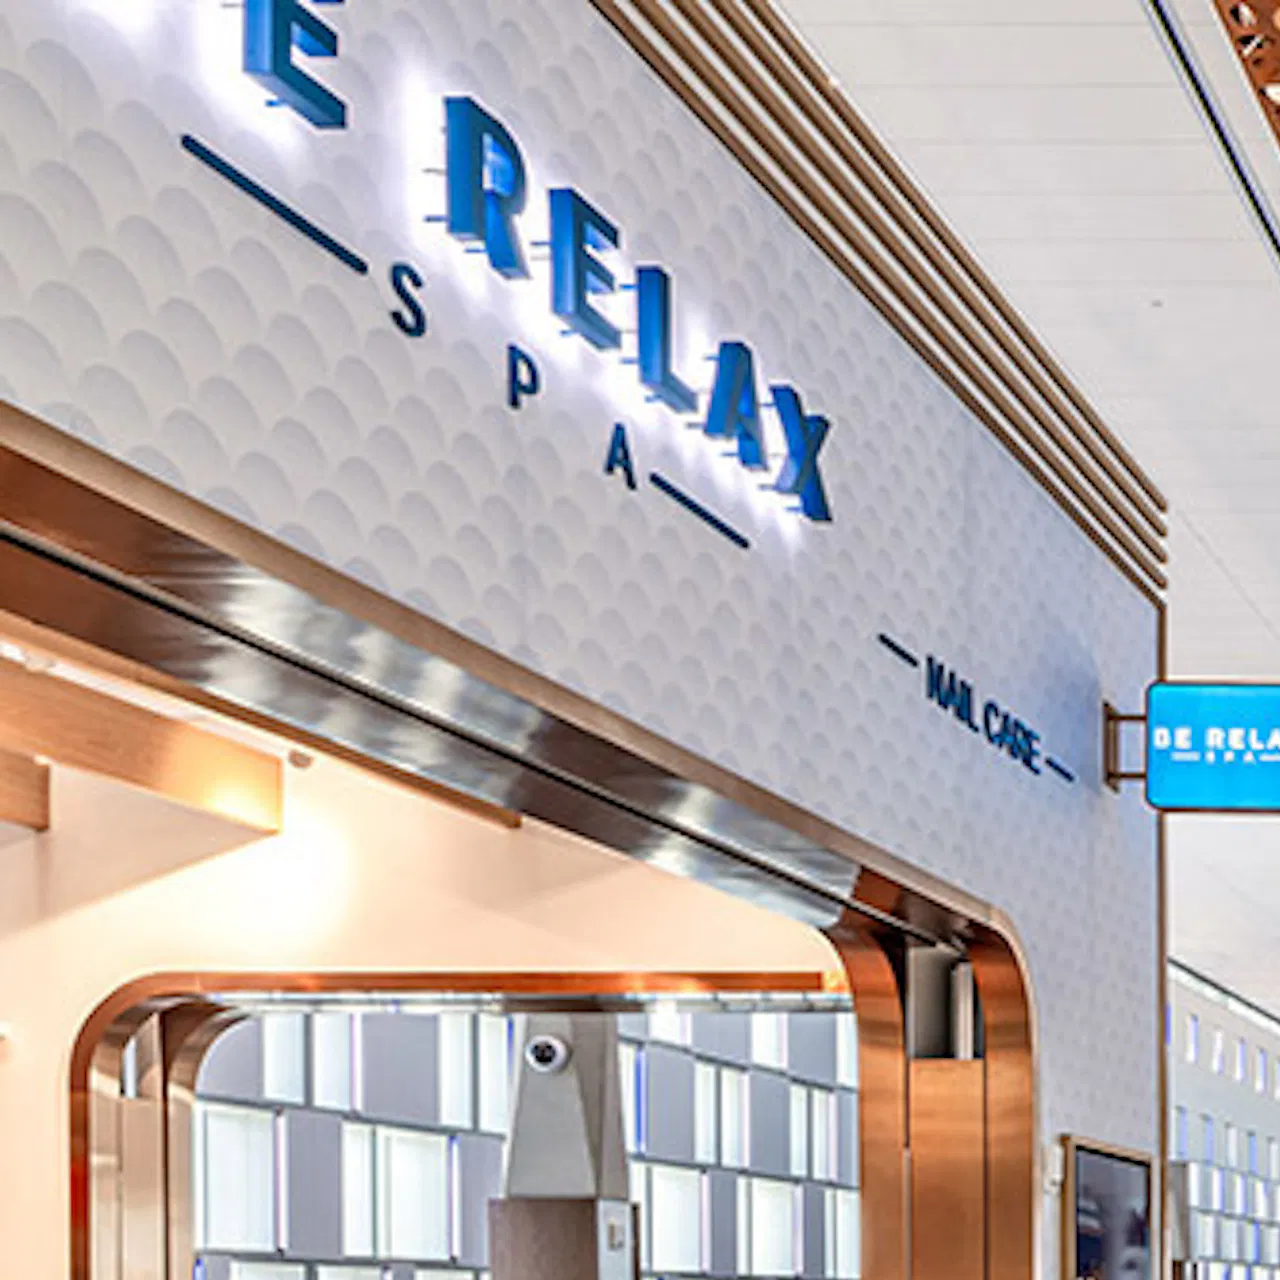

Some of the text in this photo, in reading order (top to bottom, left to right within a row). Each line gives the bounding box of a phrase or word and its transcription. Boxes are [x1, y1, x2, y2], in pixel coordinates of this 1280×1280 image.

[242, 0, 833, 523] E RELAX
[926, 653, 1042, 775] NAIL CARE
